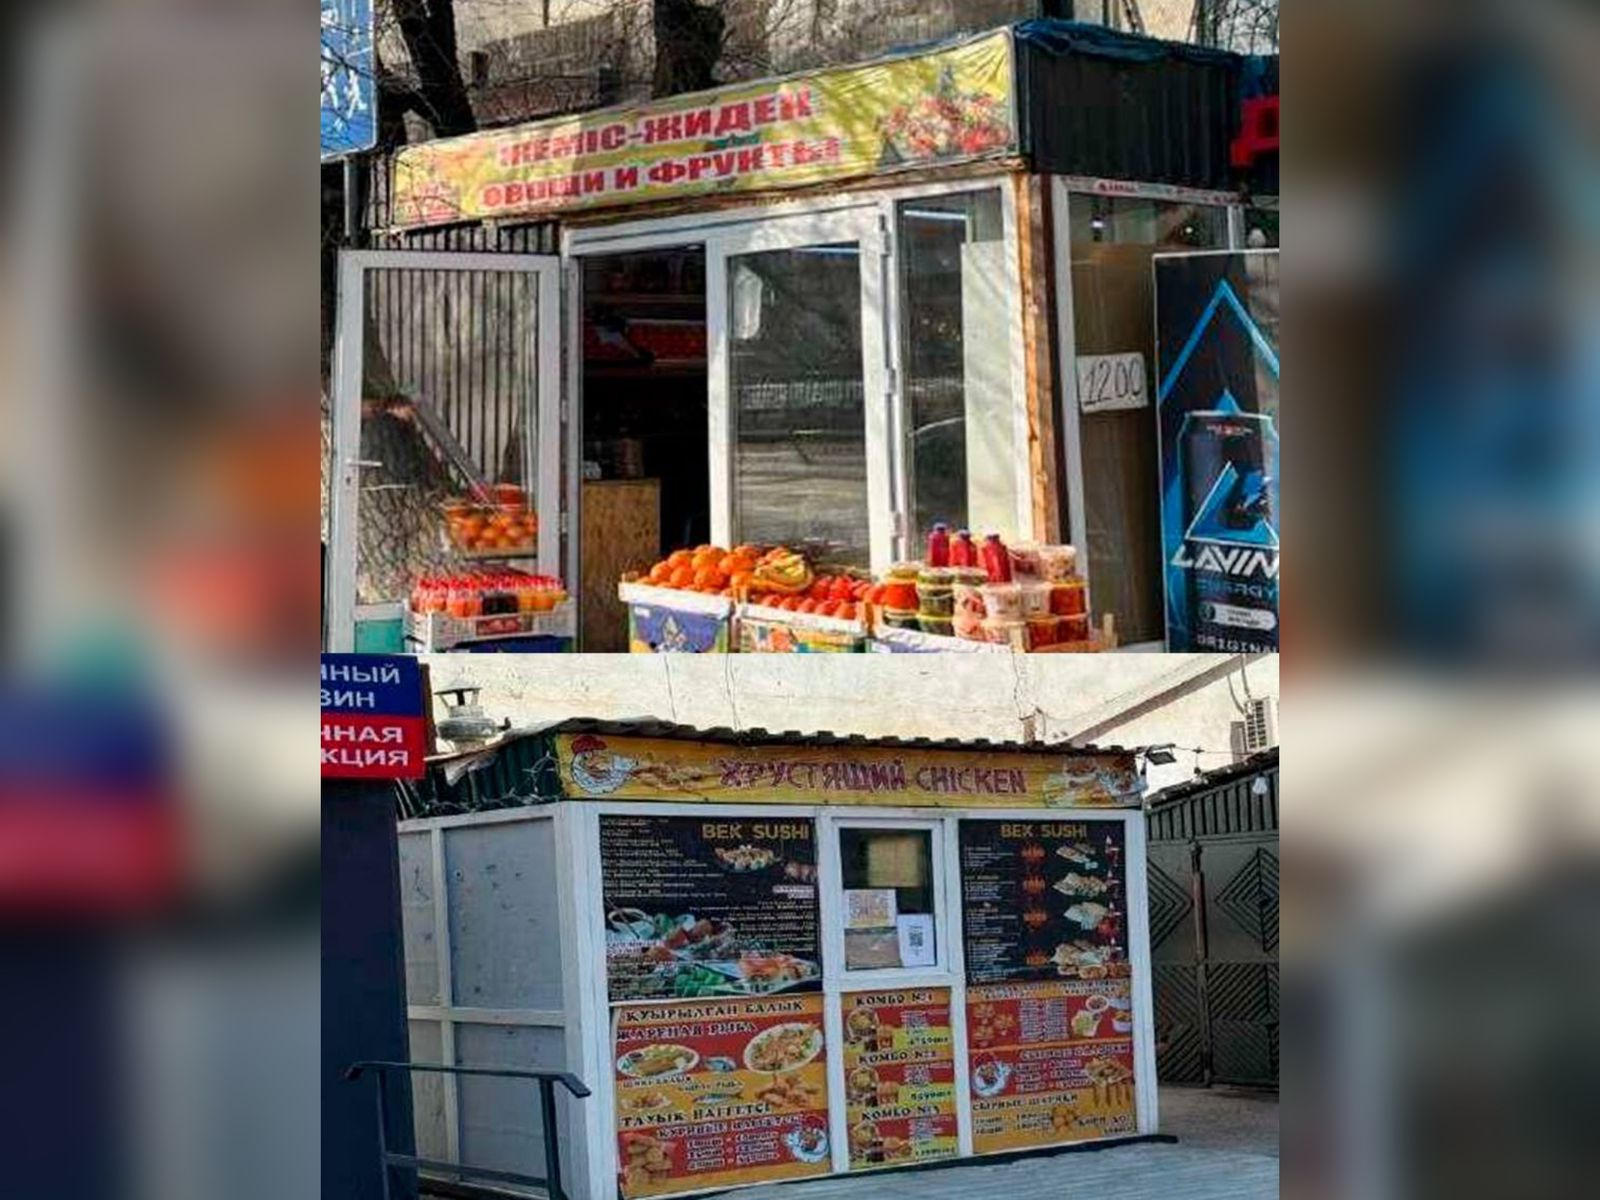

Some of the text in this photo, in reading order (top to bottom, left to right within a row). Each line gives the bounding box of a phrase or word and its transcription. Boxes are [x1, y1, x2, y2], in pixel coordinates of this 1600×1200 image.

[482, 137, 841, 208] ОВОЩИ И ФРУКТЫ
[321, 747, 409, 768] КЦИЯ
[916, 766, 1028, 795] CHICKEN
[702, 824, 809, 840] BEK SUSHI
[1000, 824, 1087, 838] BEK SUSHI
